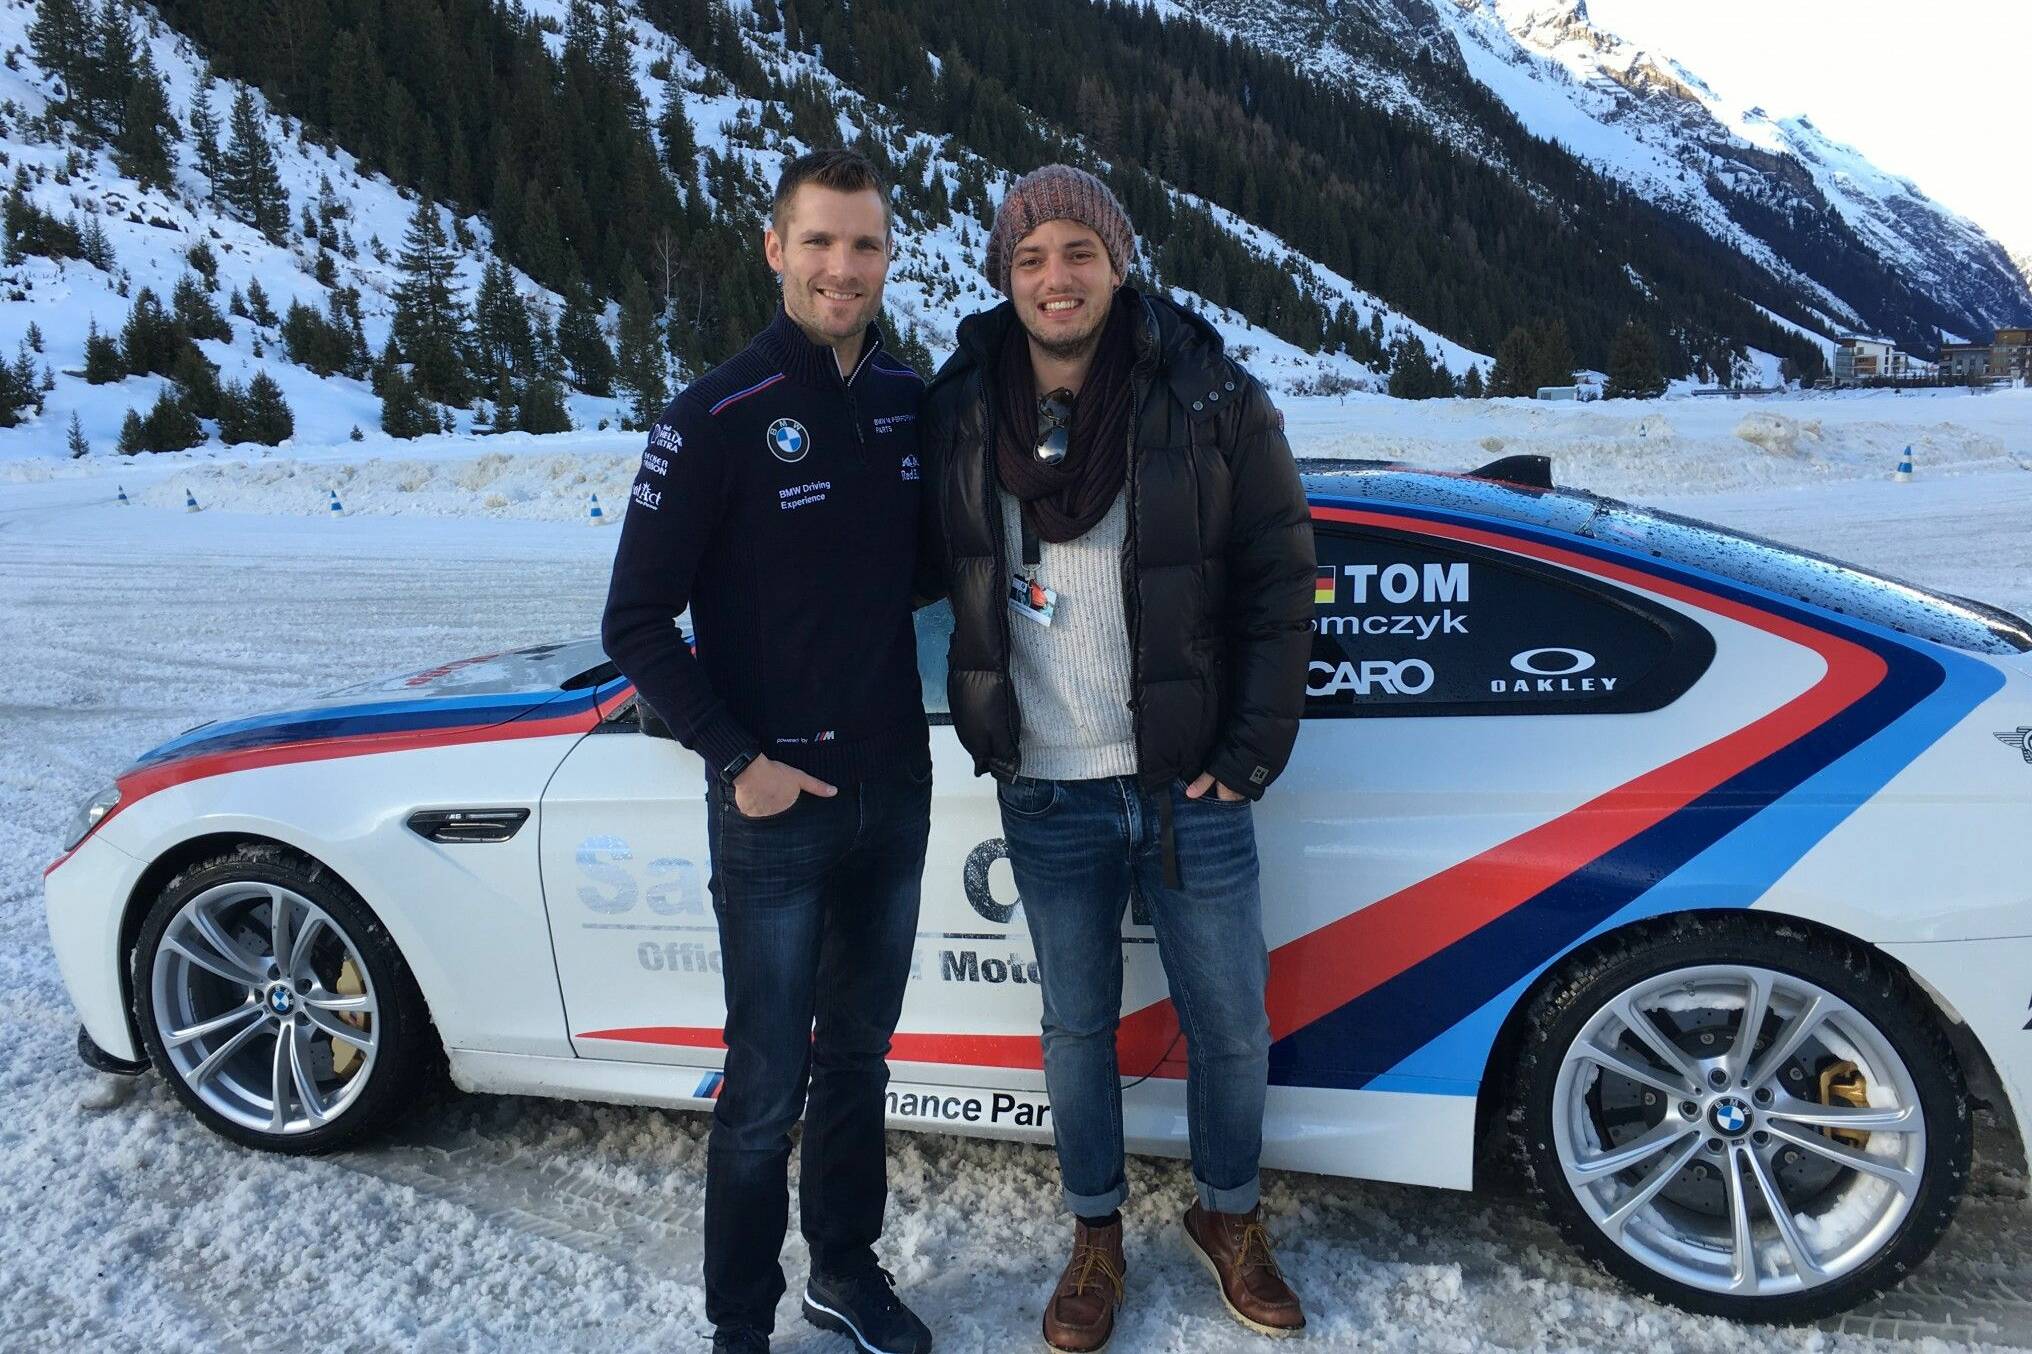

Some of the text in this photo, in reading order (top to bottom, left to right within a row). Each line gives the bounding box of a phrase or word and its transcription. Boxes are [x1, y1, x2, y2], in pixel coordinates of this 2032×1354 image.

[659, 429, 683, 447] HELIX
[875, 426, 893, 434] PARTS
[656, 438, 678, 454] ULTRA
[779, 481, 831, 499] BMW Driving
[780, 494, 826, 510] Experience
[1344, 562, 1470, 604] TOM
[1306, 658, 1435, 696] CARO
[1490, 676, 1618, 693] OAKLEY
[575, 834, 711, 916] Sa
[991, 1092, 1050, 1127] Par
